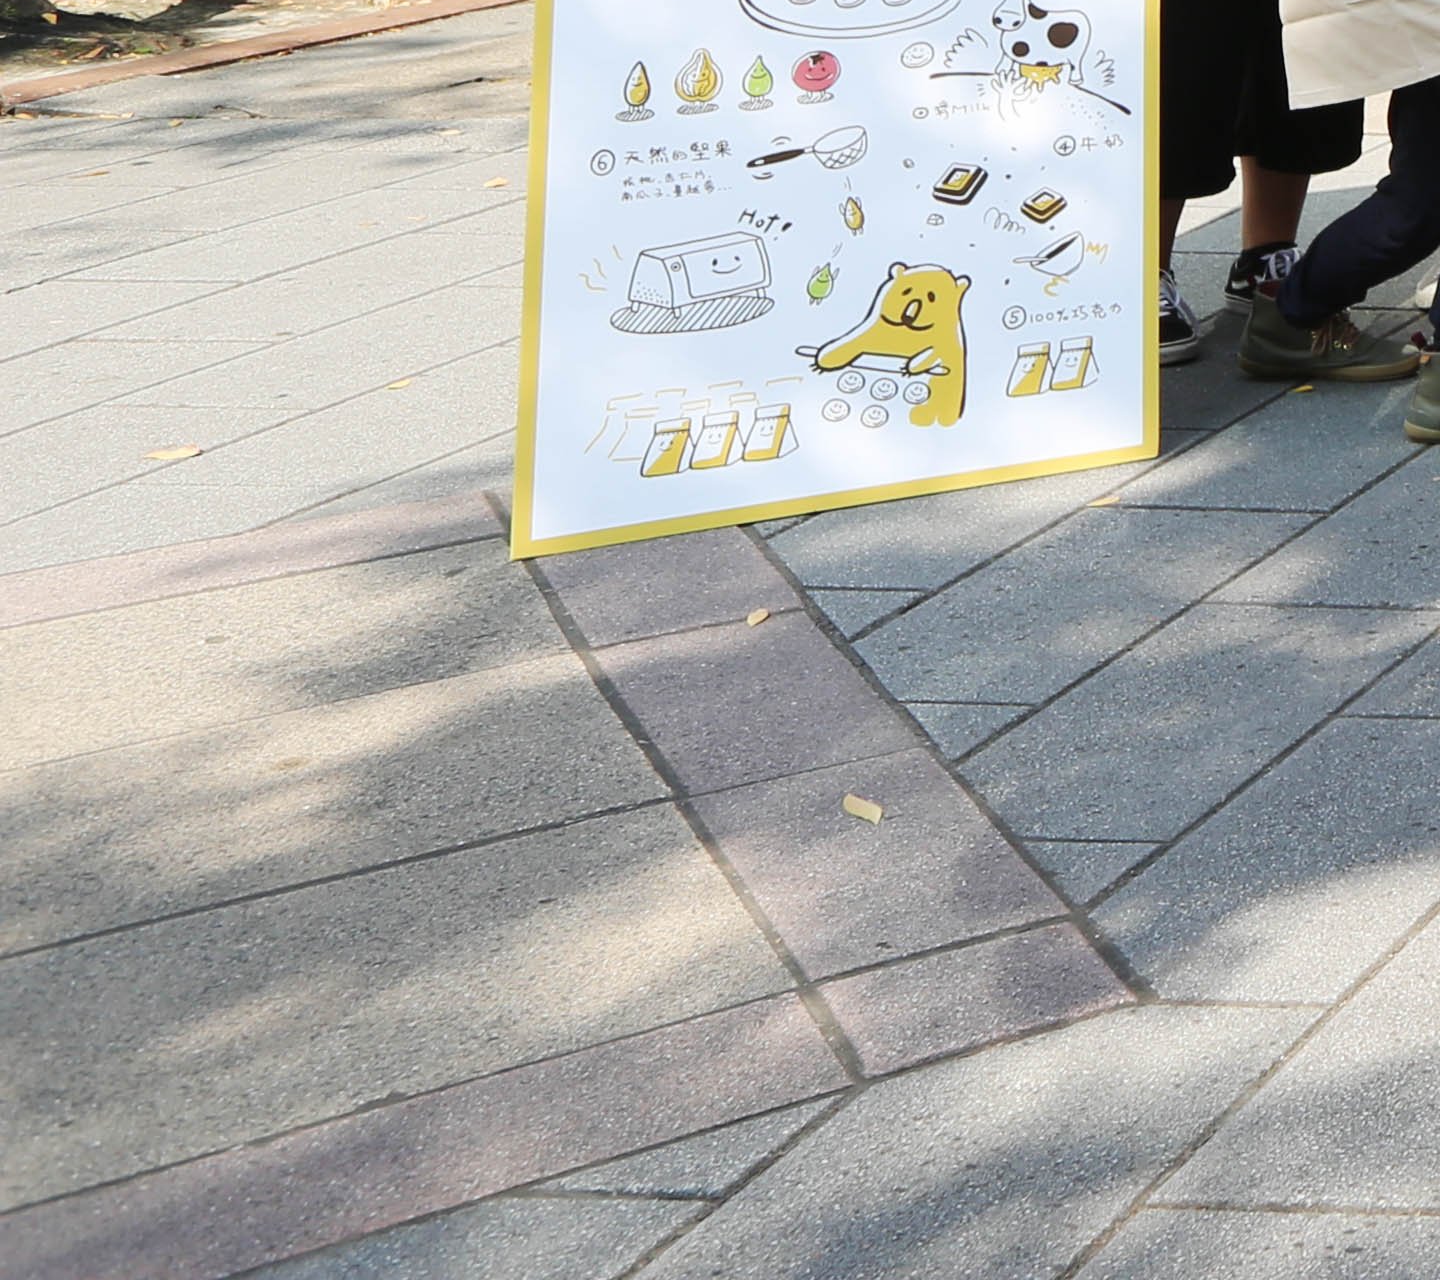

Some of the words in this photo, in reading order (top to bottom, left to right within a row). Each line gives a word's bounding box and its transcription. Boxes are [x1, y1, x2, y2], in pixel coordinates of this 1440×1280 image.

[623, 139, 733, 166] 天然的堅果
[1080, 133, 1125, 153] 牛奶
